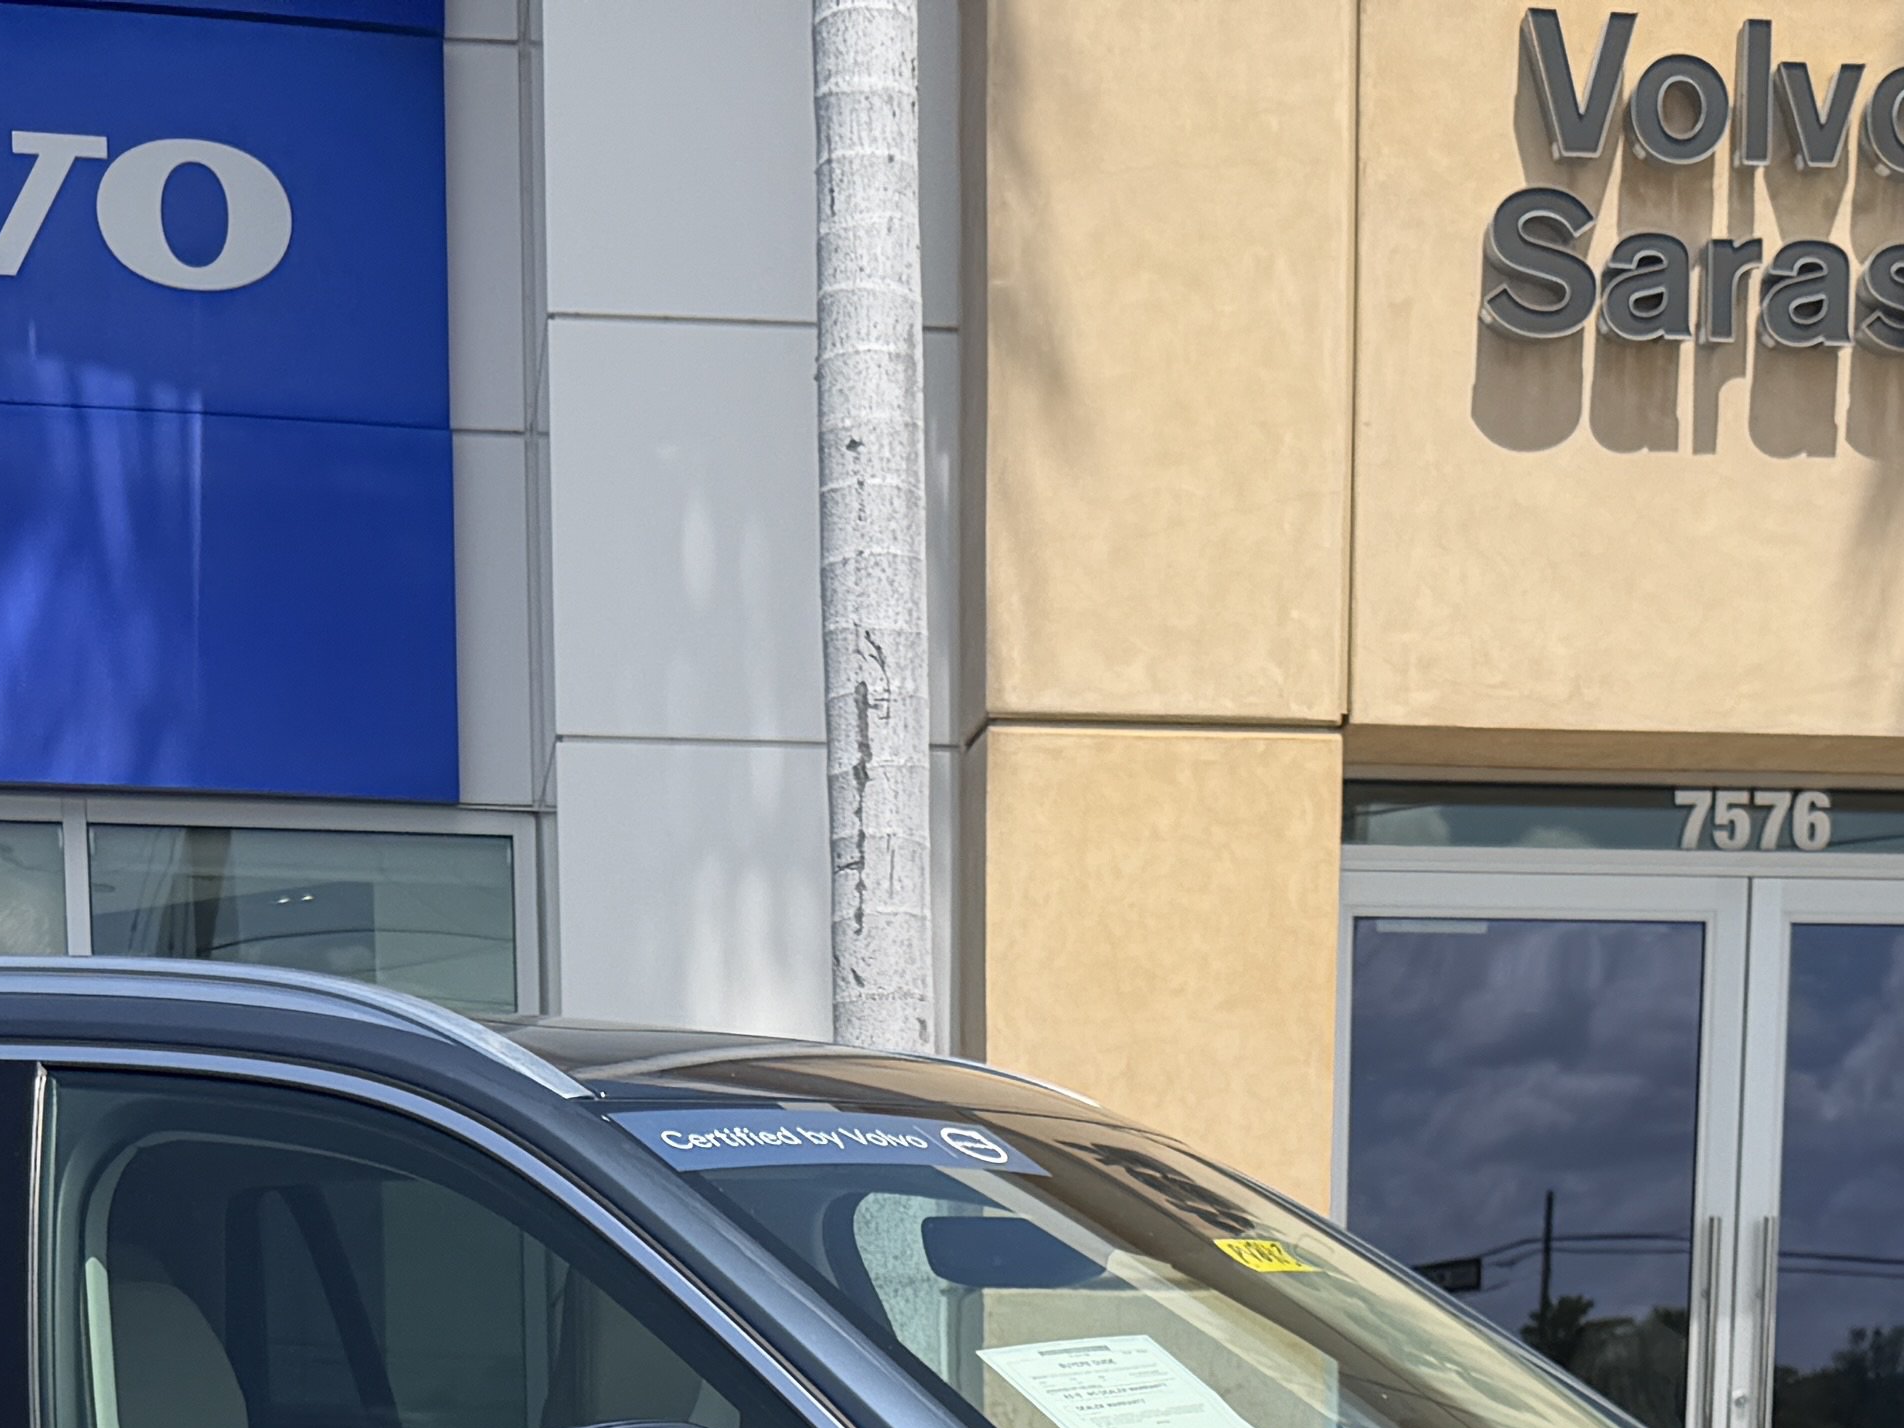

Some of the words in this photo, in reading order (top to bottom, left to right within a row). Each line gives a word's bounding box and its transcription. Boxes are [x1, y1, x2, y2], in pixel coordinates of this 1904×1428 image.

[1674, 790, 1832, 851] 7576
[660, 1126, 801, 1151] Certified
[797, 1126, 846, 1150] by
[840, 1127, 929, 1150] Volvo
